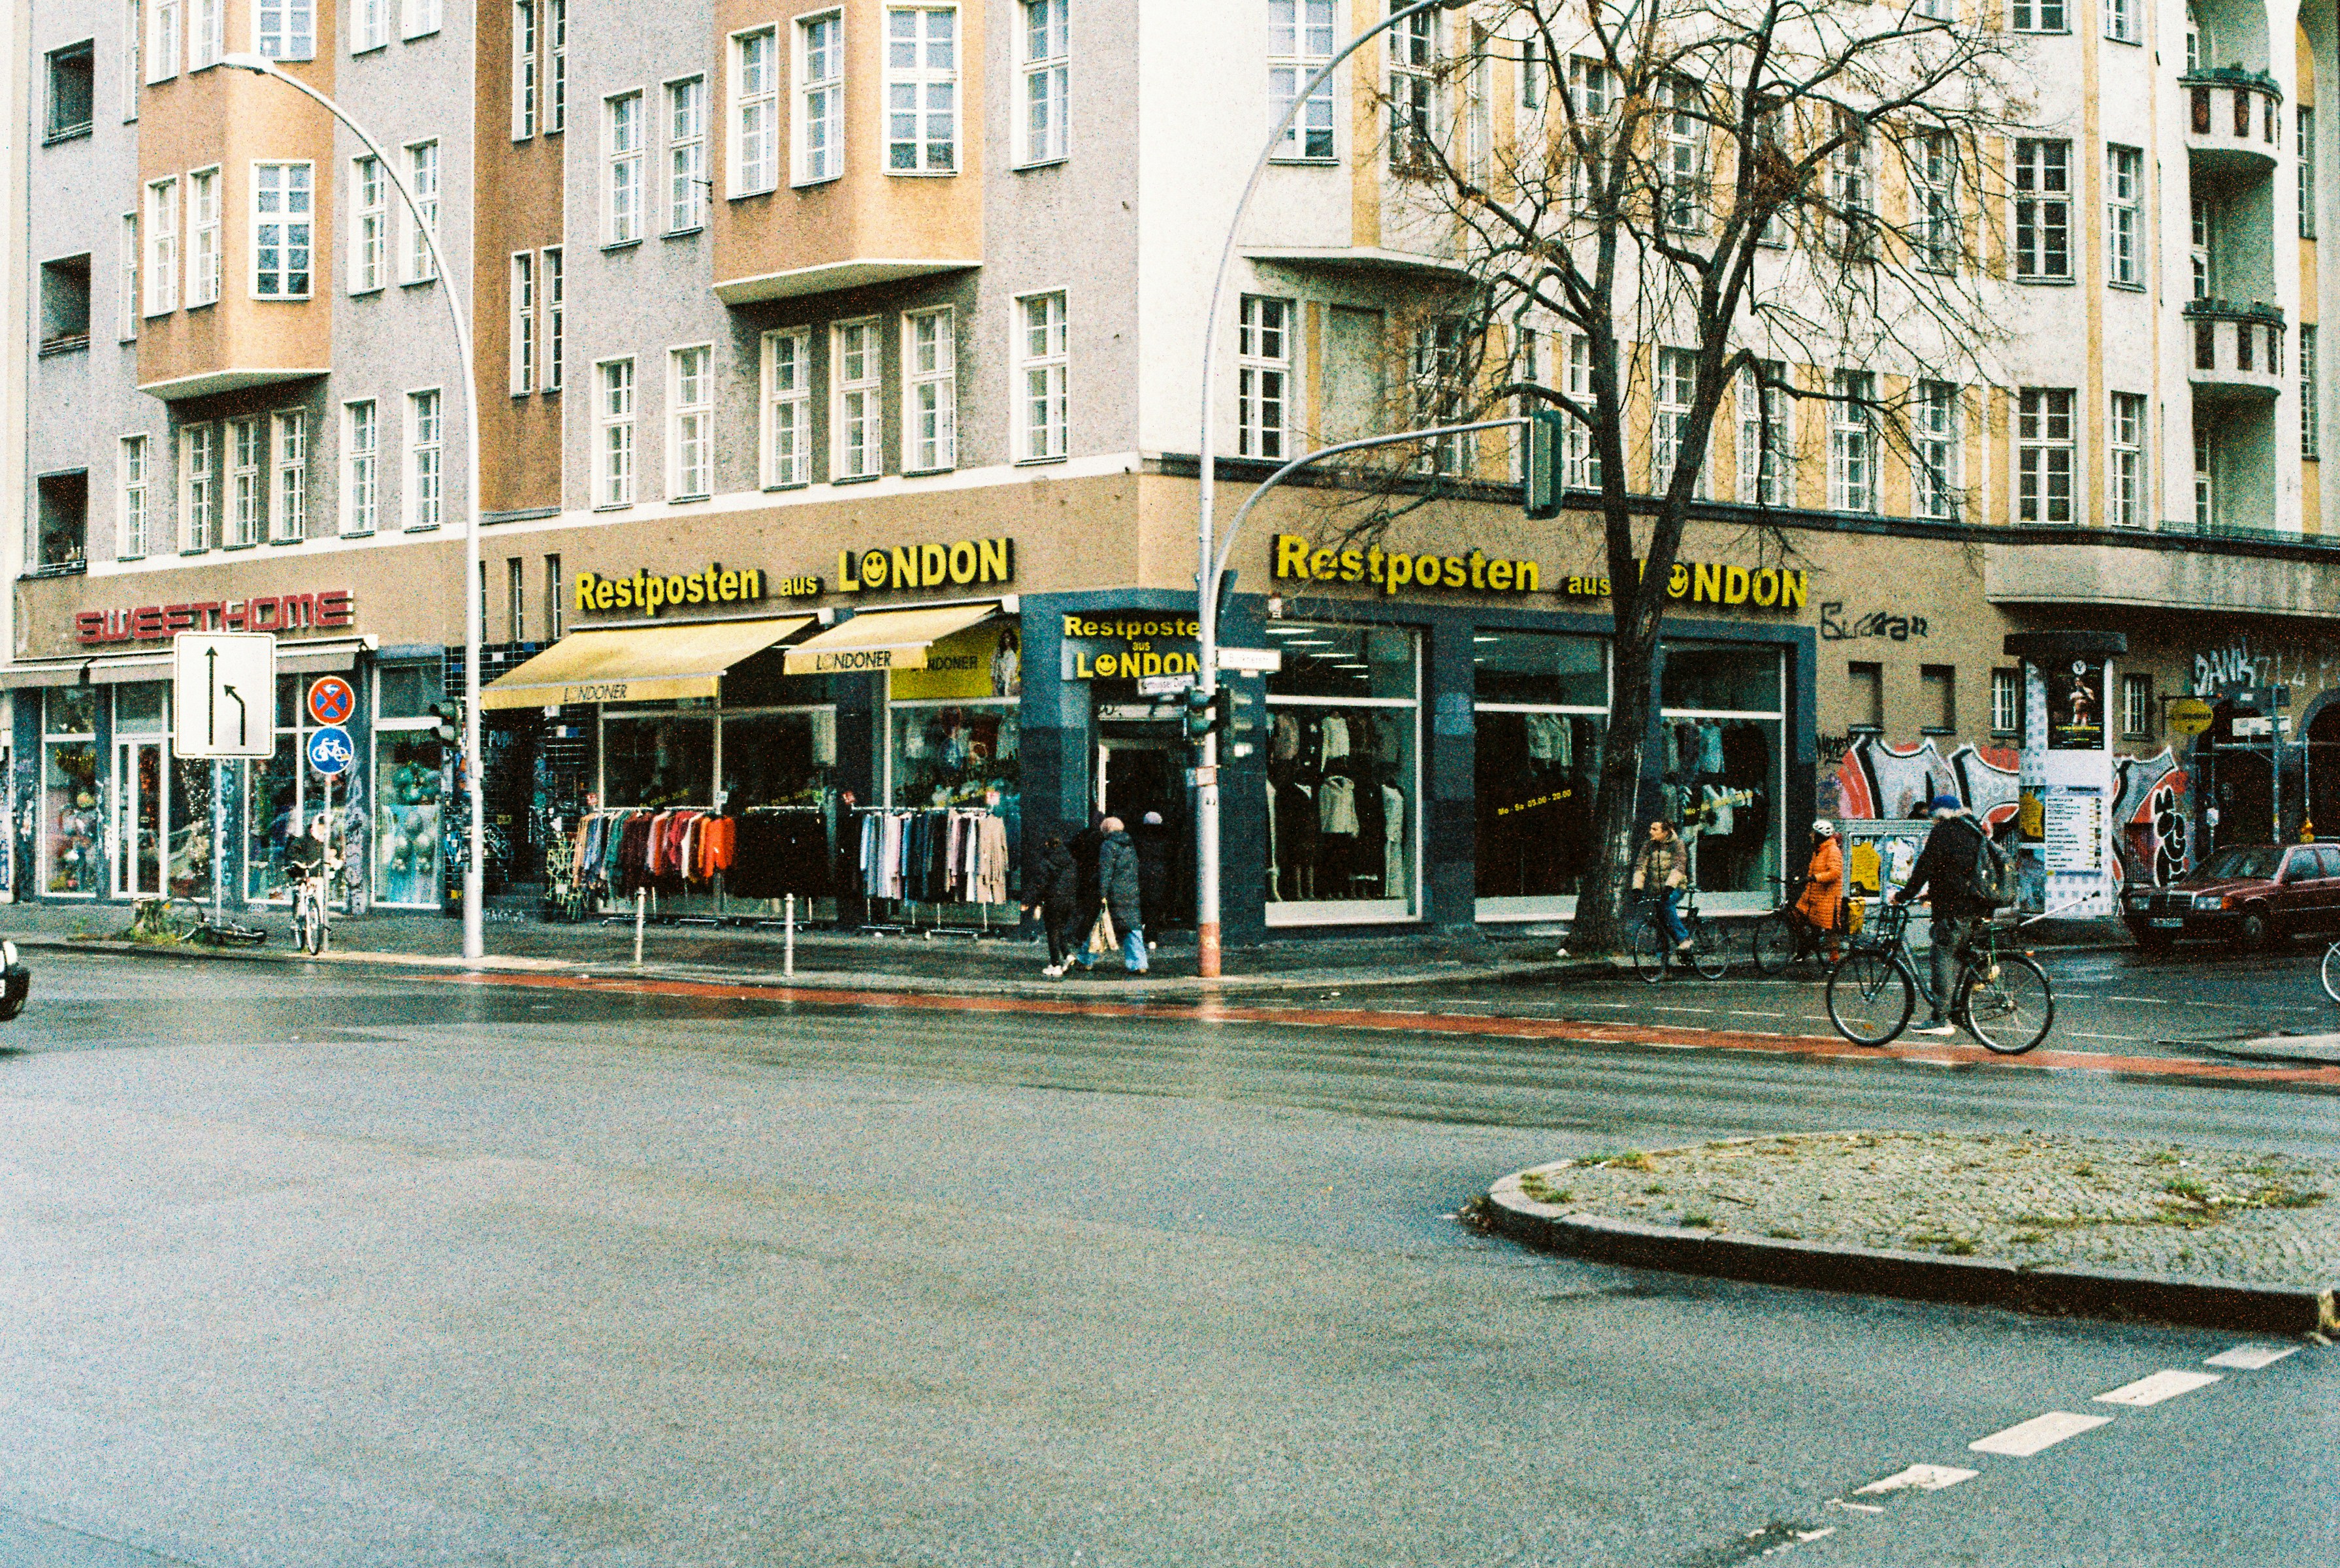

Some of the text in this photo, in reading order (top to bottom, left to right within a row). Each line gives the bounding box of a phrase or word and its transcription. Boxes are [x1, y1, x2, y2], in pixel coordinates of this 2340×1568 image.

[575, 564, 760, 616] Restposten
[781, 577, 818, 596] aus
[1277, 534, 1808, 608] Restposten aus ONDON
[75, 590, 354, 644] SWEETHOME
[1064, 616, 1201, 641] Restposte
[1131, 641, 1151, 652] aus
